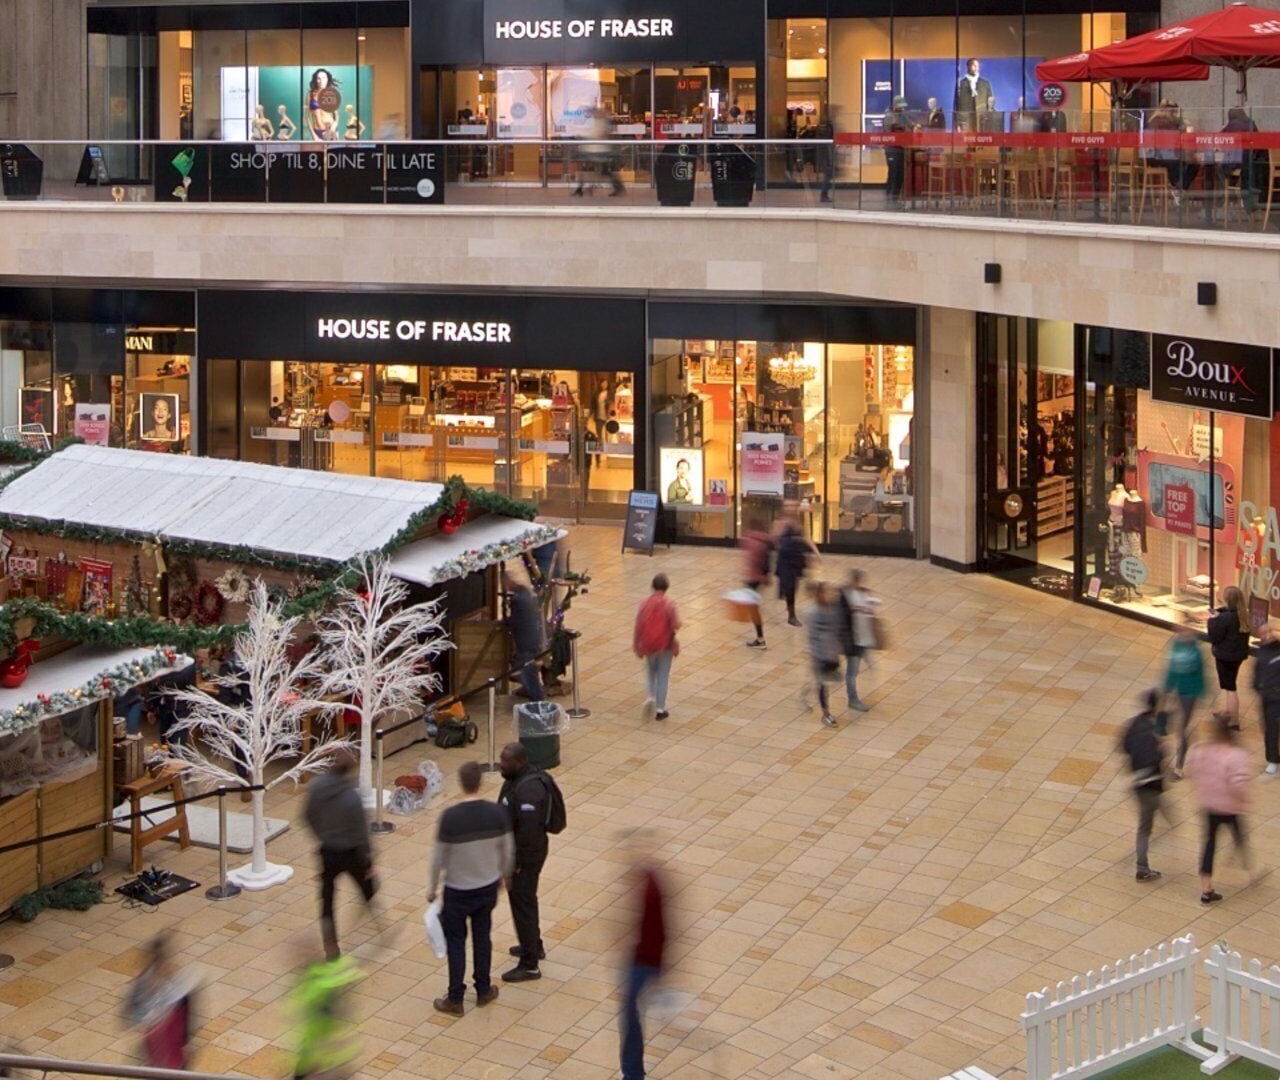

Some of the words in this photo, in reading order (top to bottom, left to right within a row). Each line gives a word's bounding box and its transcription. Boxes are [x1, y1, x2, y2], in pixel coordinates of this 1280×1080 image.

[495, 21, 562, 39] HOUSE
[568, 20, 595, 38] OF
[601, 19, 673, 37] FRASER
[1215, 137, 1234, 145] GUYS
[230, 153, 276, 169] SHOP
[282, 153, 301, 169] 'TIL
[327, 153, 365, 169] DINE
[402, 153, 435, 169] LATE
[318, 319, 390, 339] HOUSE
[396, 321, 426, 340] OF
[432, 321, 511, 343] FRASER
[1167, 340, 1255, 394] Boux
[1185, 386, 1237, 403] AVENUE
[1168, 489, 1188, 503] FREE
[1167, 501, 1186, 513] TOP
[1239, 563, 1280, 600] 70%
